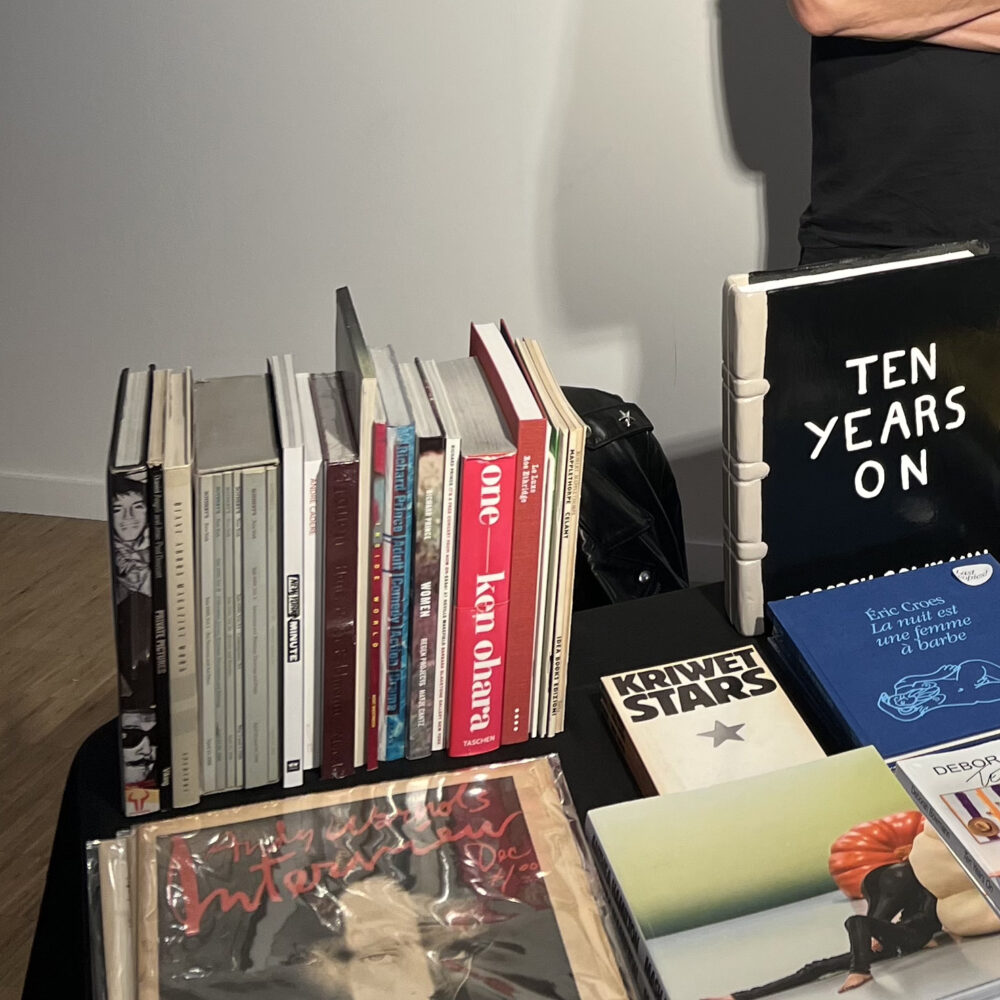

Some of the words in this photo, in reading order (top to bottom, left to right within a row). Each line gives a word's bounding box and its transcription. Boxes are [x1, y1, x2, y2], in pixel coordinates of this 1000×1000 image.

[846, 342, 937, 395] TEN
[804, 385, 966, 460] YEARS
[394, 443, 409, 491] Richard
[566, 449, 575, 504] MAPPLETHORPE
[854, 449, 928, 499] ON
[393, 495, 406, 533] Prince
[480, 464, 502, 526] one
[562, 511, 571, 539] CELANT
[392, 540, 406, 572] Adult
[371, 596, 380, 648] WORLD
[390, 576, 404, 624] Comedy
[419, 581, 431, 618] WOMEN
[475, 571, 505, 635] ken
[865, 606, 899, 622] Éric
[901, 595, 946, 612] Croes
[870, 622, 892, 634] La
[899, 611, 933, 627] nuit
[937, 605, 959, 618] est
[288, 620, 299, 662] MINUTE
[388, 630, 402, 667] Action
[876, 630, 910, 647] une
[913, 615, 972, 641] femme
[901, 642, 913, 655] à
[918, 630, 968, 650] barbe
[469, 638, 501, 733] ohara
[612, 647, 760, 697] KRIWET
[623, 667, 777, 723] STARS
[463, 735, 496, 747] TASCHEN
[984, 880, 994, 894] On
